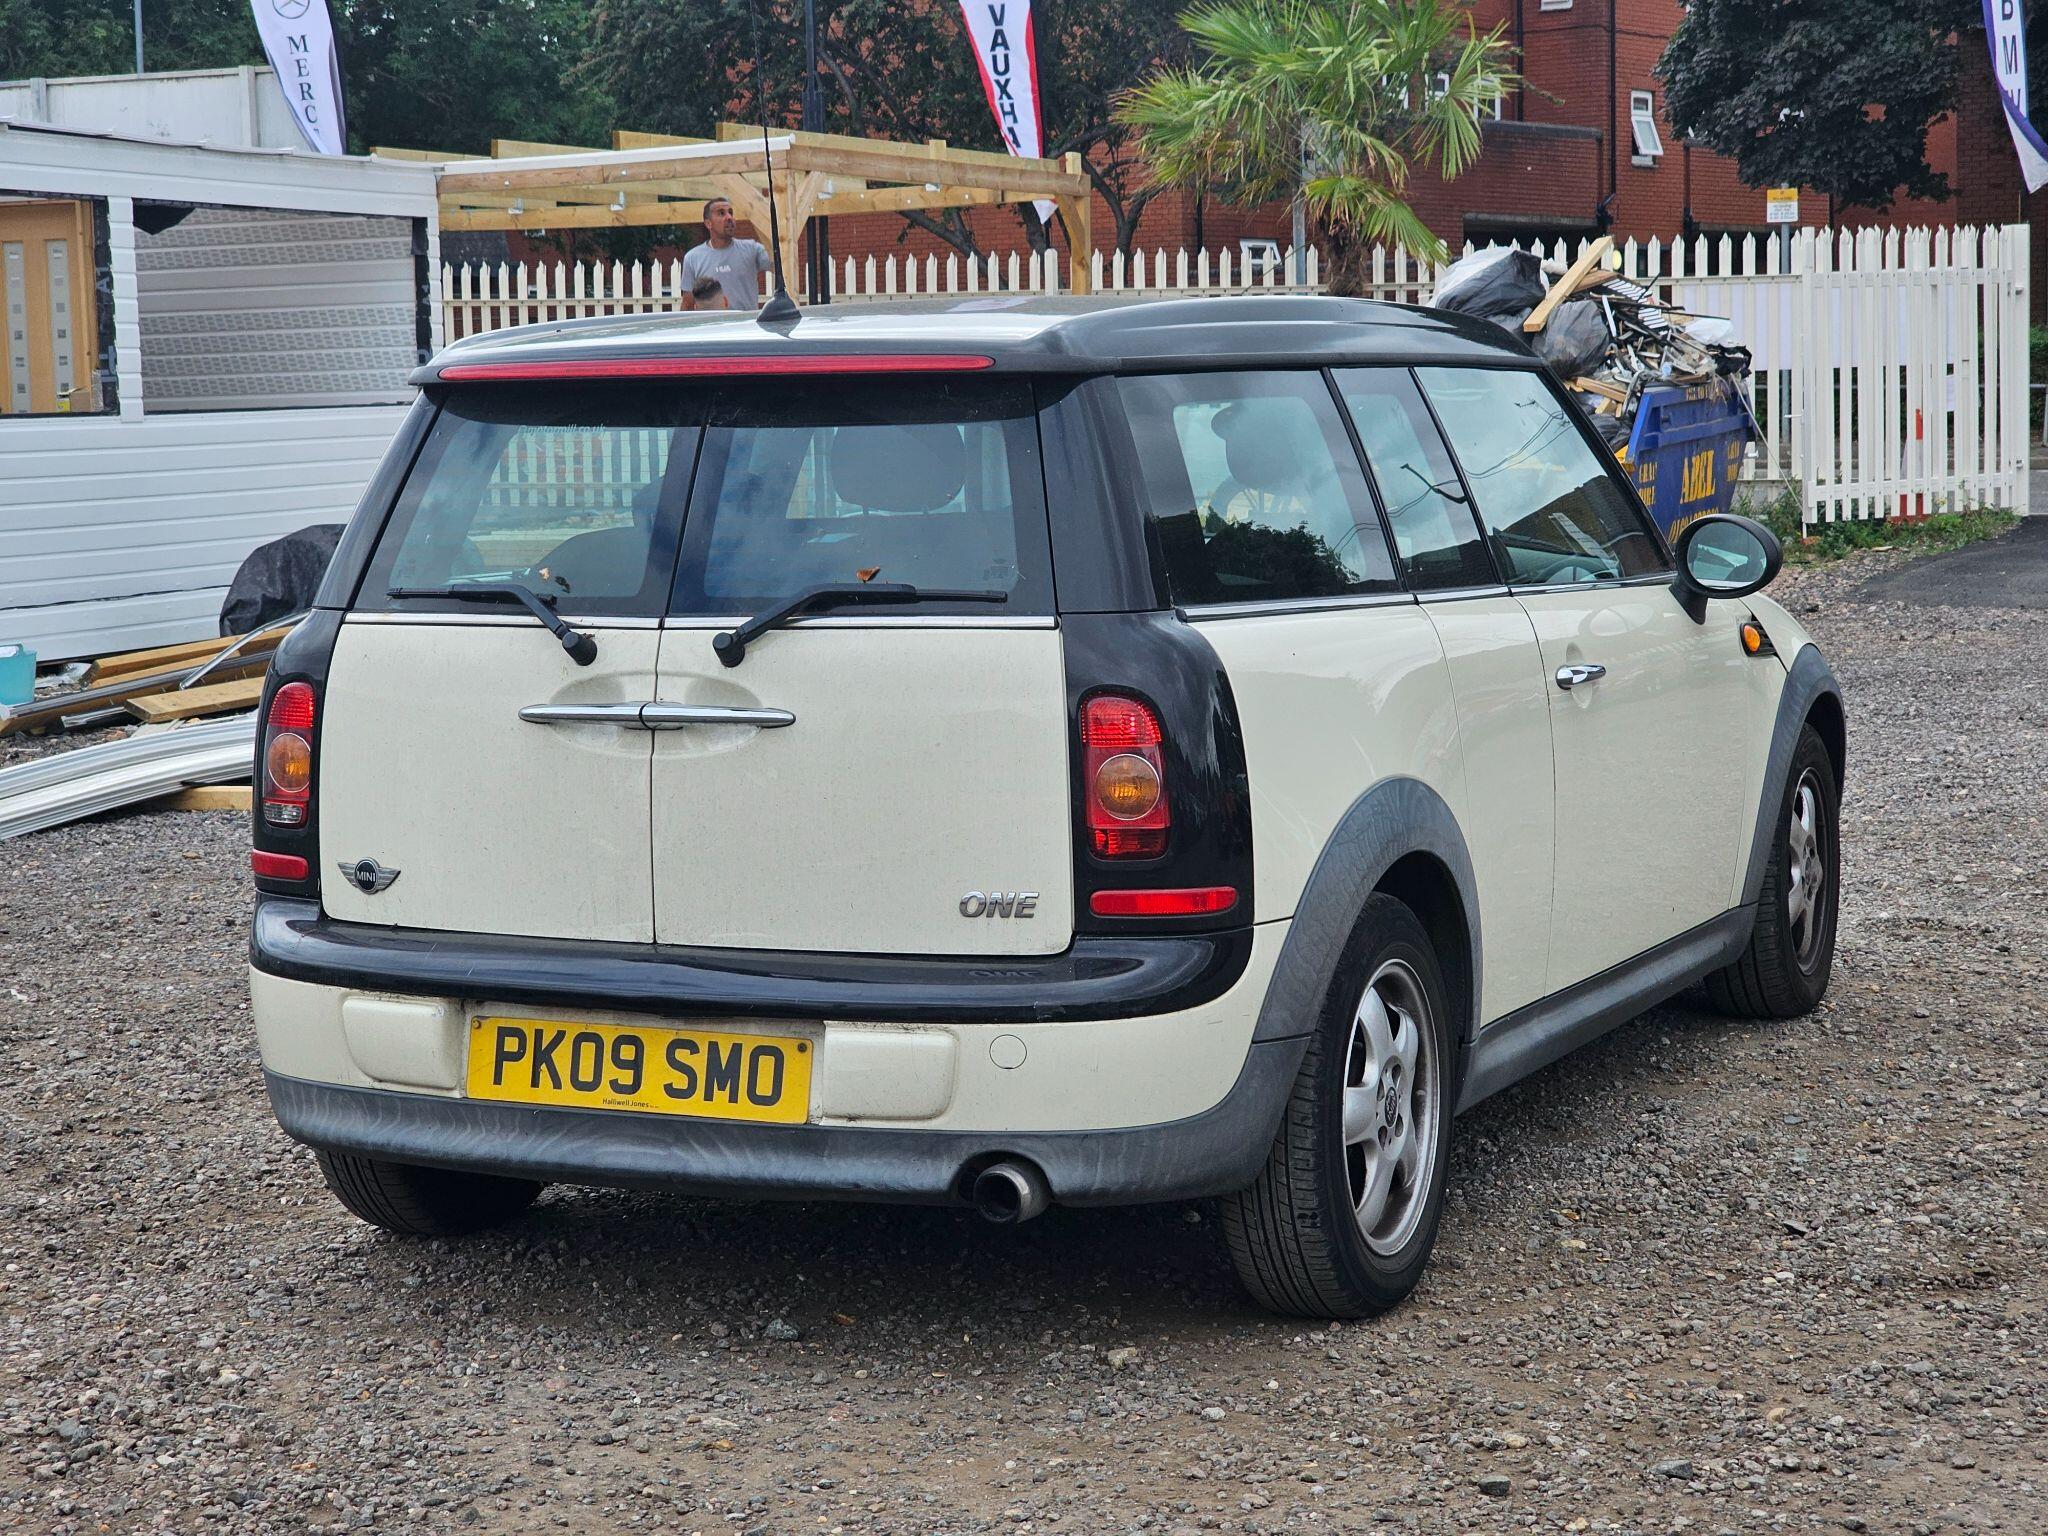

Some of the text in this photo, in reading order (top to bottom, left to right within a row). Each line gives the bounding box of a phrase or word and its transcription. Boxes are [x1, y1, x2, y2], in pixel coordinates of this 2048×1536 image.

[286, 34, 320, 137] MERC
[1680, 450, 1716, 504] ABEL
[356, 870, 376, 882] MINI
[959, 890, 1040, 919] ONE
[492, 1025, 786, 1108] PK09 SMO
